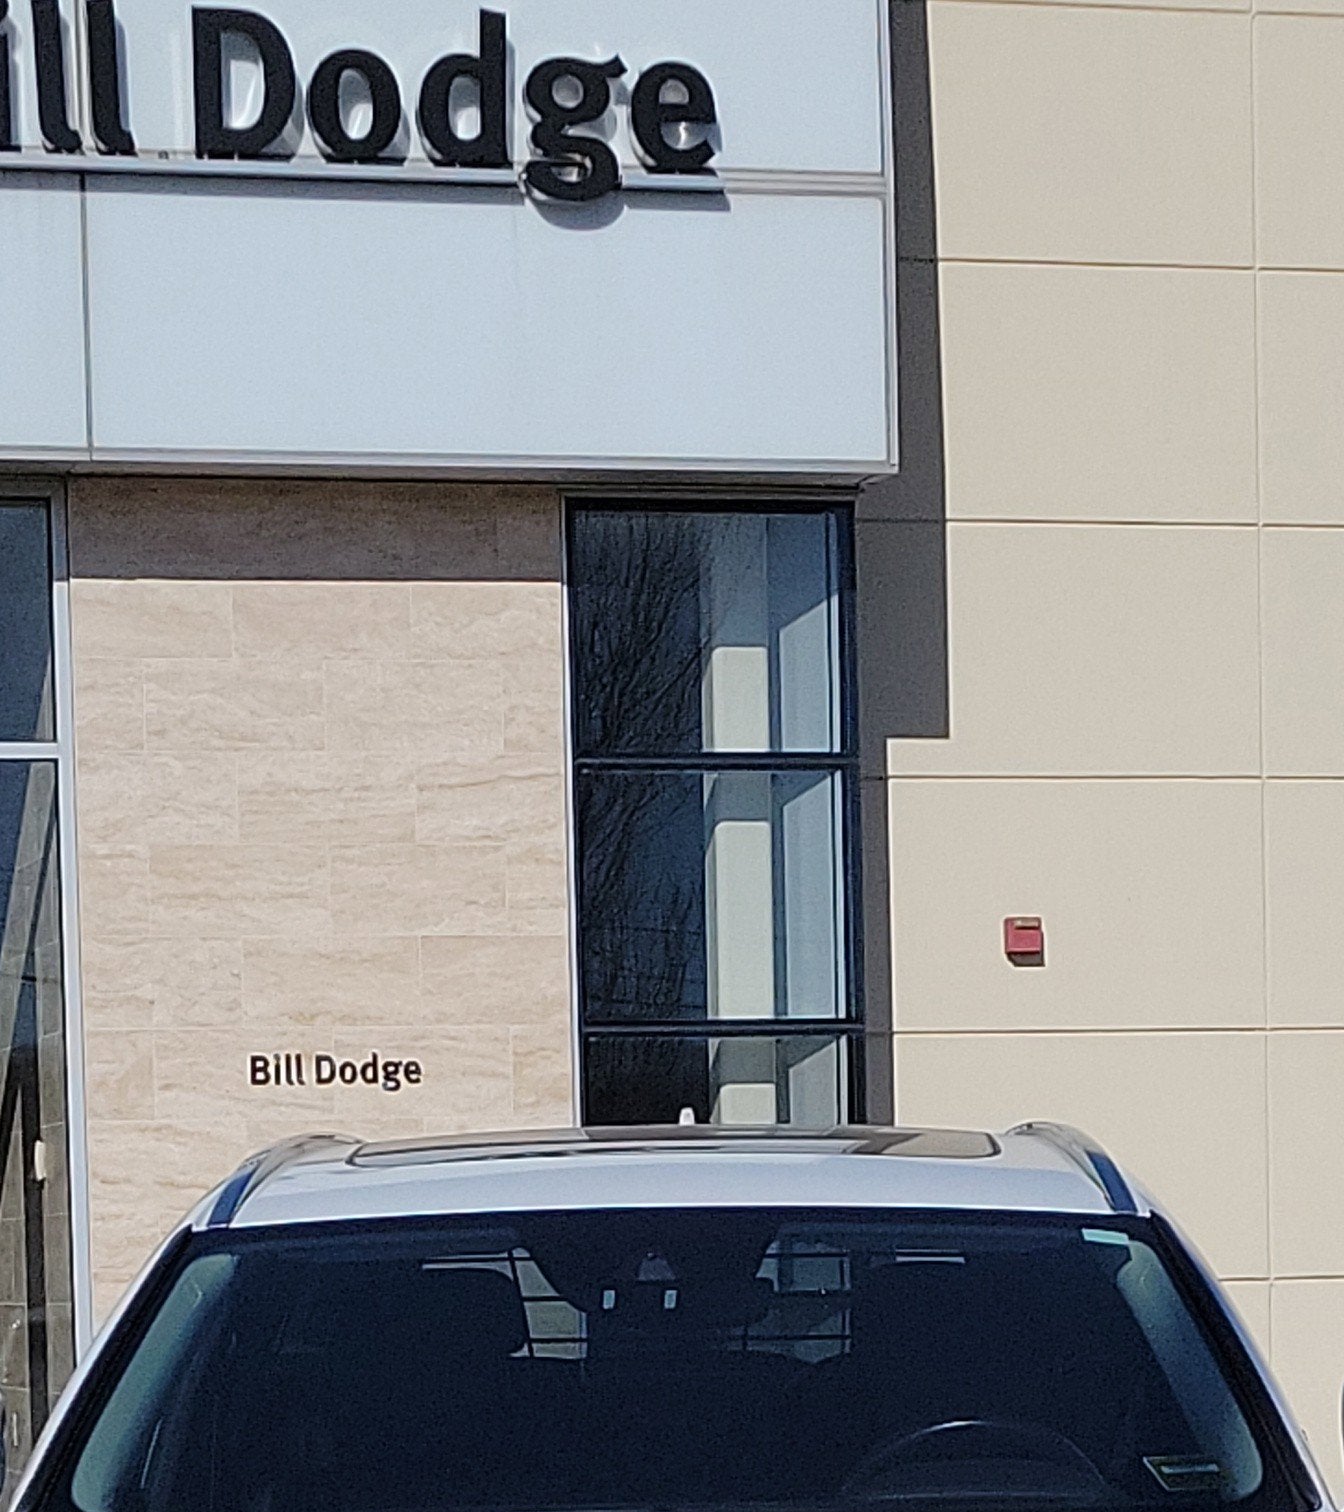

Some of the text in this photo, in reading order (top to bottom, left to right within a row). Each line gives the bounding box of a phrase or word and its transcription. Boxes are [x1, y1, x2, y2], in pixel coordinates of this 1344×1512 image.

[190, 4, 720, 202] Dodge
[250, 1052, 422, 1091] Bill Dodge
